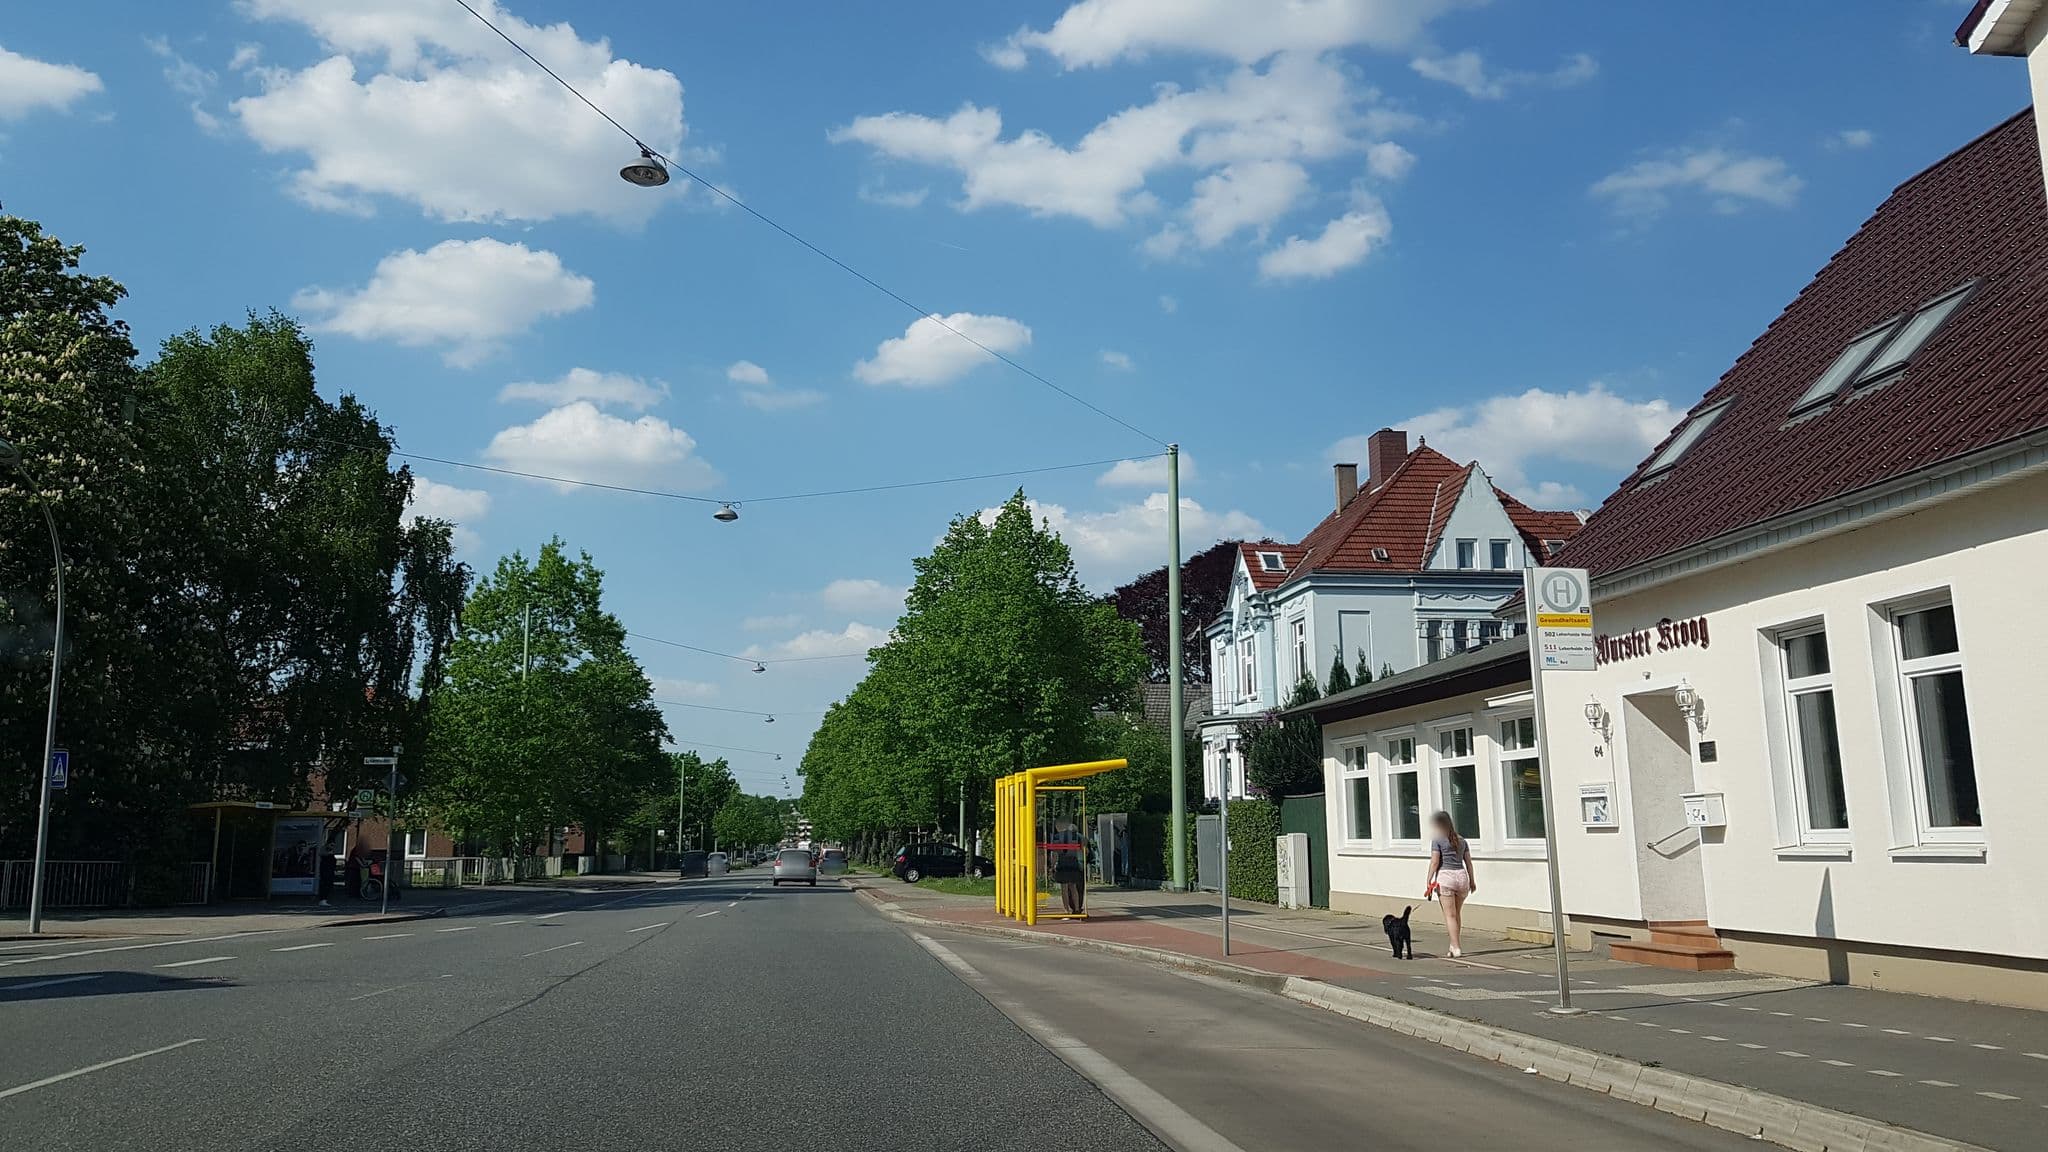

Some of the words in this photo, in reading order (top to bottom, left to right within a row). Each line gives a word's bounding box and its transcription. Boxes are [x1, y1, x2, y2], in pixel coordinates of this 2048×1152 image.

[1552, 580, 1571, 604] H
[1656, 617, 1710, 653] Kroog
[1594, 745, 1604, 758] 64
